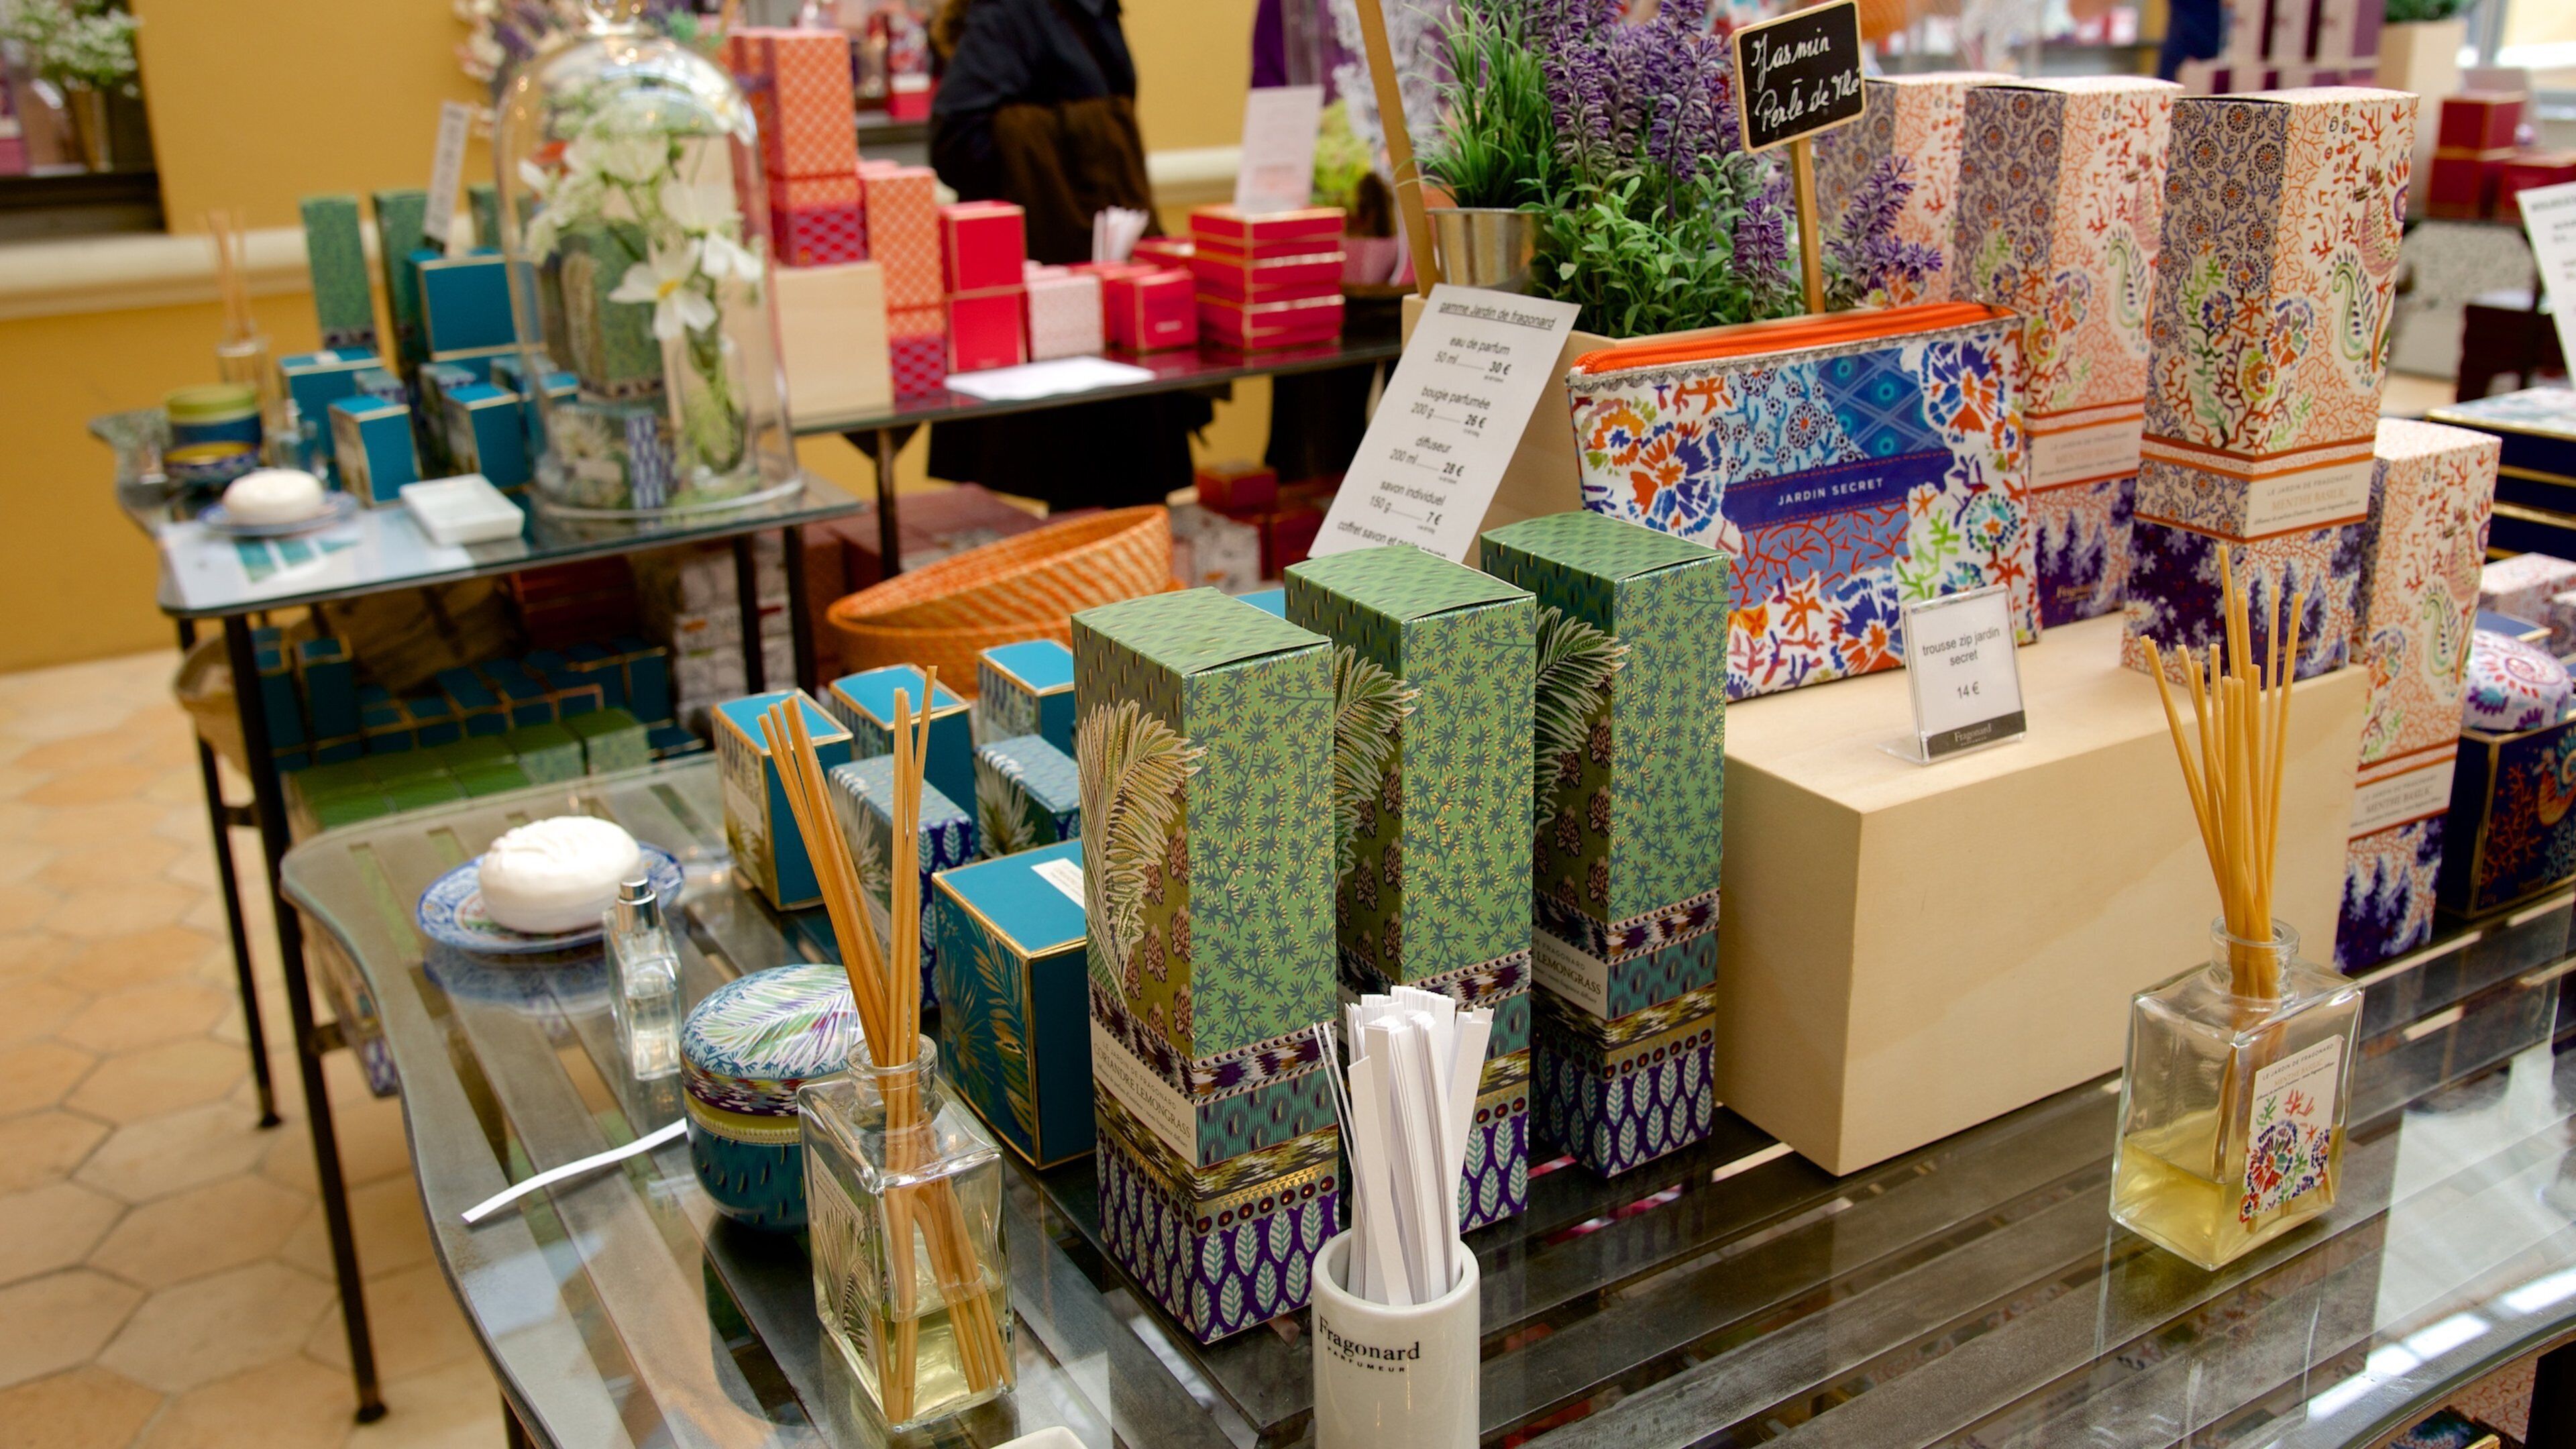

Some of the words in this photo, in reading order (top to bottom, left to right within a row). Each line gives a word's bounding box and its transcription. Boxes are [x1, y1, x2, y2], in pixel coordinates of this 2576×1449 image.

[1751, 28, 1831, 93] Jasmin
[1807, 78, 1830, 113] de
[1439, 302, 1468, 315] gamme
[1470, 304, 1496, 319] Jardin
[1497, 309, 1509, 321] de
[1511, 310, 1556, 329] fragonard
[1449, 336, 1464, 348] eau
[1466, 337, 1478, 350] de
[1478, 341, 1511, 356] parfum
[1435, 351, 1447, 363] 50
[1447, 353, 1459, 365] ml
[1489, 361, 1501, 374] 30
[1503, 364, 1511, 376] €
[1421, 386, 1449, 402] bougie
[1449, 392, 1491, 411] parfumée
[1411, 402, 1426, 415] 200
[1426, 408, 1434, 419] g
[1464, 415, 1477, 427] 26
[1479, 417, 1487, 429] €
[1415, 436, 1452, 453] diffuseur
[1389, 449, 1407, 462] 200
[1407, 453, 1419, 466] ml
[1456, 466, 1464, 478] €
[1379, 480, 1405, 496] savon
[1405, 486, 1447, 506] individuel
[1778, 488, 1826, 506] JARDIN
[1831, 477, 1884, 496] SECRET
[1369, 495, 1385, 509] 150
[1426, 512, 1435, 523] 7
[1434, 514, 1443, 526] €
[1337, 520, 1364, 537] coffret
[1362, 528, 1388, 543] savon
[1922, 639, 1957, 656] trousse
[1959, 634, 1973, 647] zip
[1974, 627, 2000, 645] jardin
[1949, 649, 1978, 666] secret
[1956, 684, 1970, 699] 14
[1972, 681, 1980, 695] €
[1542, 942, 1585, 971] FRAGONARD
[1537, 951, 1601, 995] LEMONGRASS
[1093, 1042, 1135, 1091] CORIANDRE
[1135, 1083, 1191, 1138] LEMONGRASS
[1140, 1075, 1177, 1110] FRAGONARD
[1319, 1313, 1421, 1361] Fragonard
[1327, 1346, 1405, 1373] PARFUMEUR
